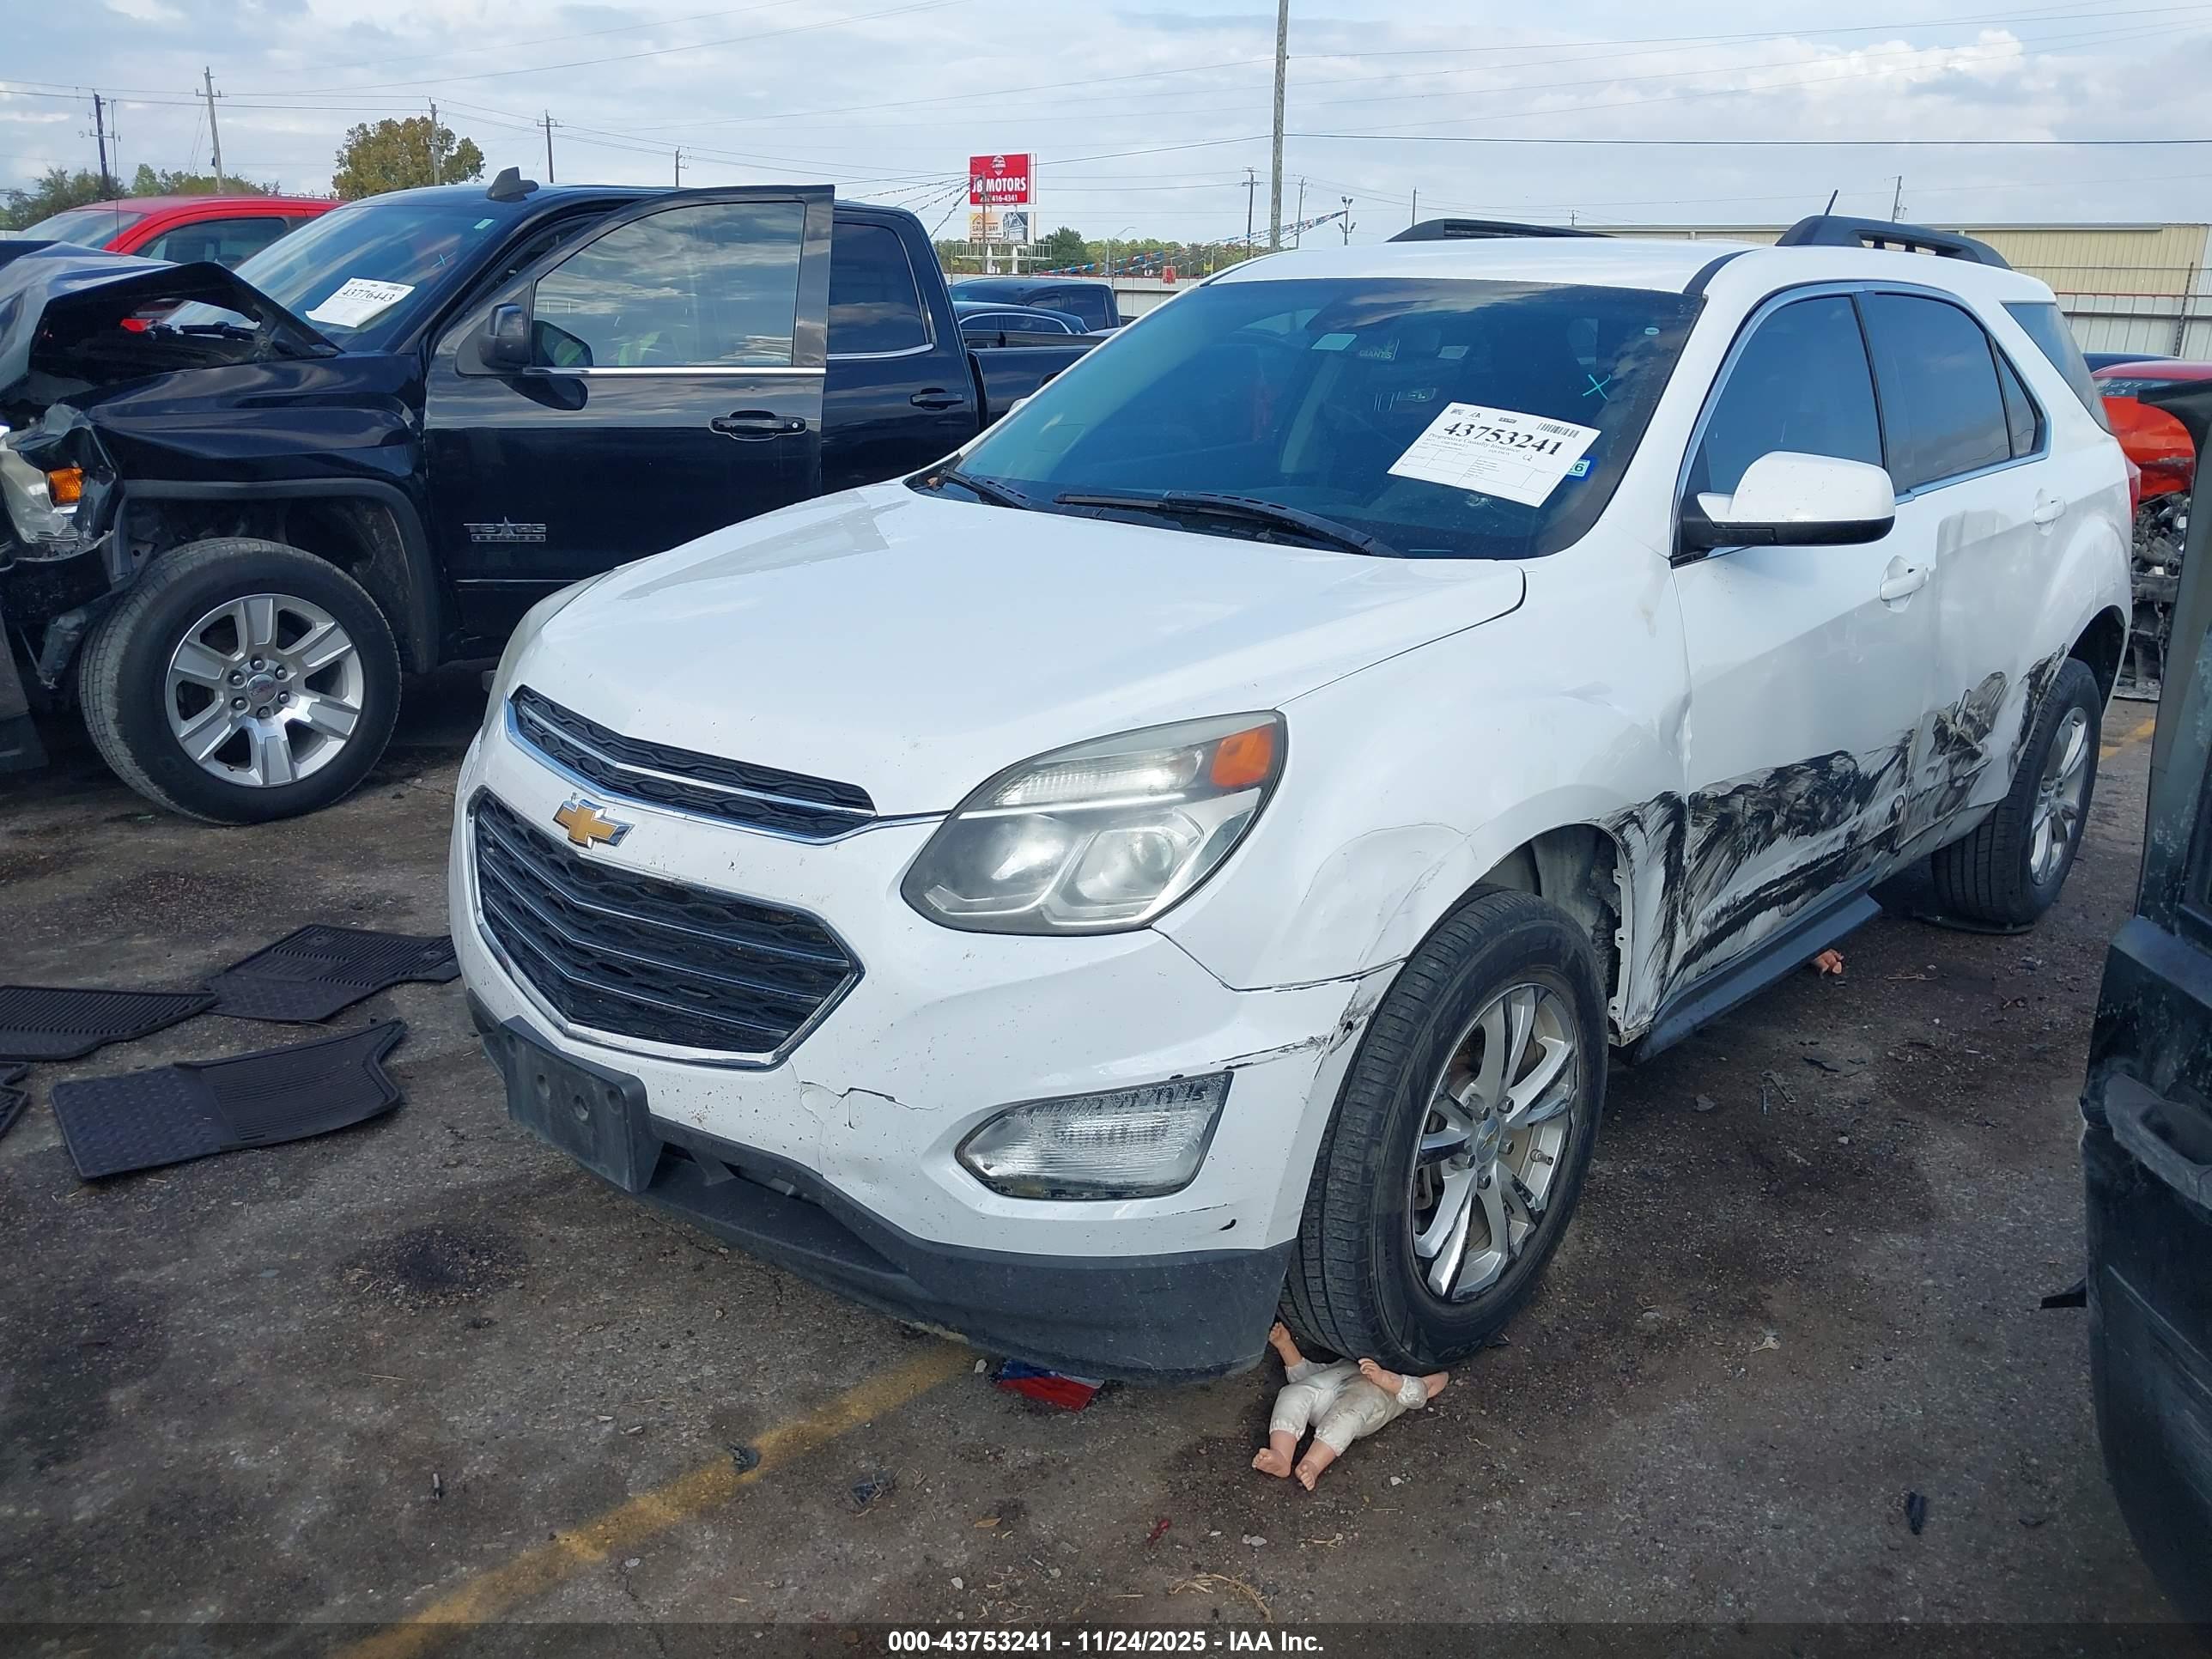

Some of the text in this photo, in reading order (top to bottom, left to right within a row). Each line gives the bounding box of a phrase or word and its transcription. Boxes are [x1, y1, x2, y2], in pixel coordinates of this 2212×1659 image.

[986, 177, 1026, 191] MOTORS
[342, 288, 395, 301] 43776443
[1443, 422, 1565, 457] 43753241
[1463, 438, 1490, 447] Casualty
[1490, 443, 1521, 453] Insurance
